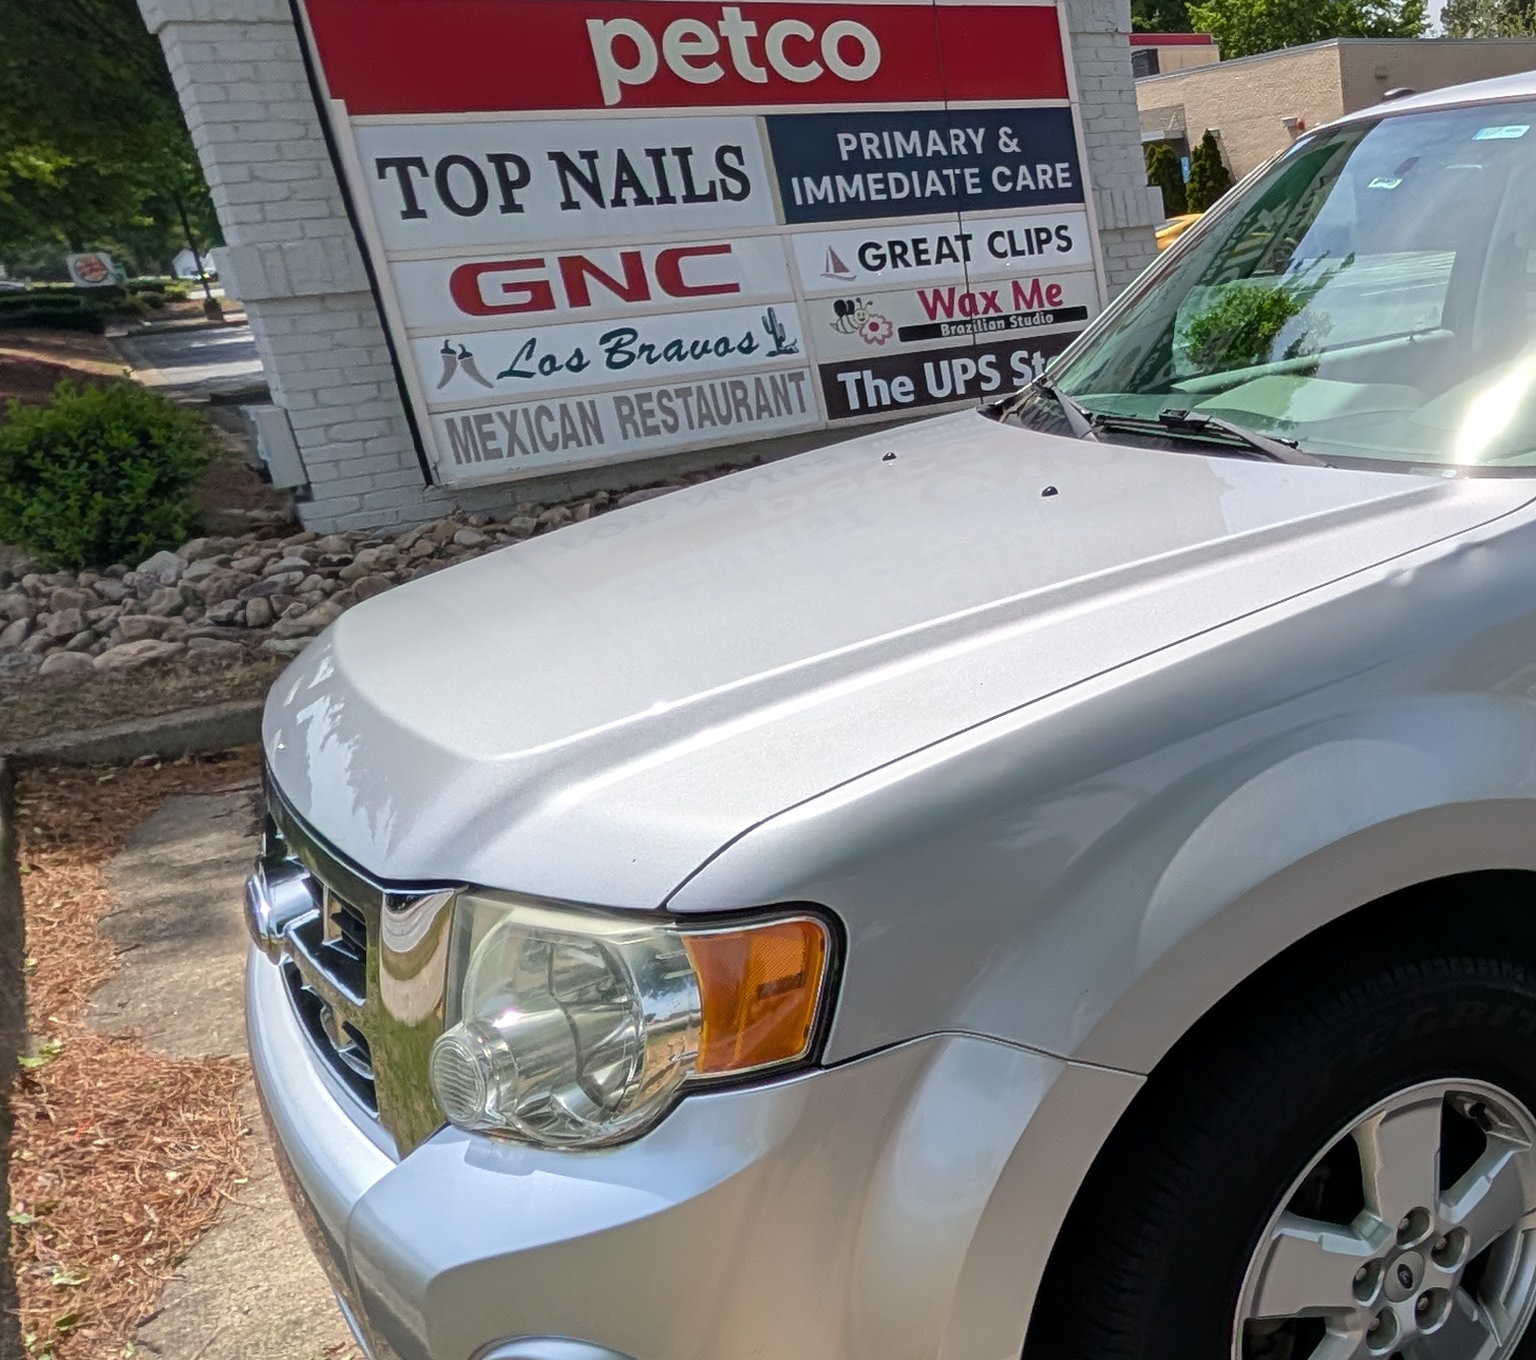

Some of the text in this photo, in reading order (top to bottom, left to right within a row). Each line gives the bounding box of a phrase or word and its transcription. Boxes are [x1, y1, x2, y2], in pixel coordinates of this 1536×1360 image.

[586, 6, 881, 106] petco
[837, 126, 1022, 161] PRIMARY &
[376, 145, 751, 220] TOP NAILS
[791, 162, 1073, 206] IMMEDIATE CARE
[858, 225, 1073, 271] GREAT CLIPS
[449, 244, 740, 316] GNC
[917, 278, 1064, 321] Wax Me
[940, 312, 1054, 337] Brazilian Studio
[496, 327, 759, 380] Los Bravos
[837, 370, 914, 410] The
[923, 354, 1001, 398] UPS
[445, 371, 807, 465] MEXICAN RESTAURANT
